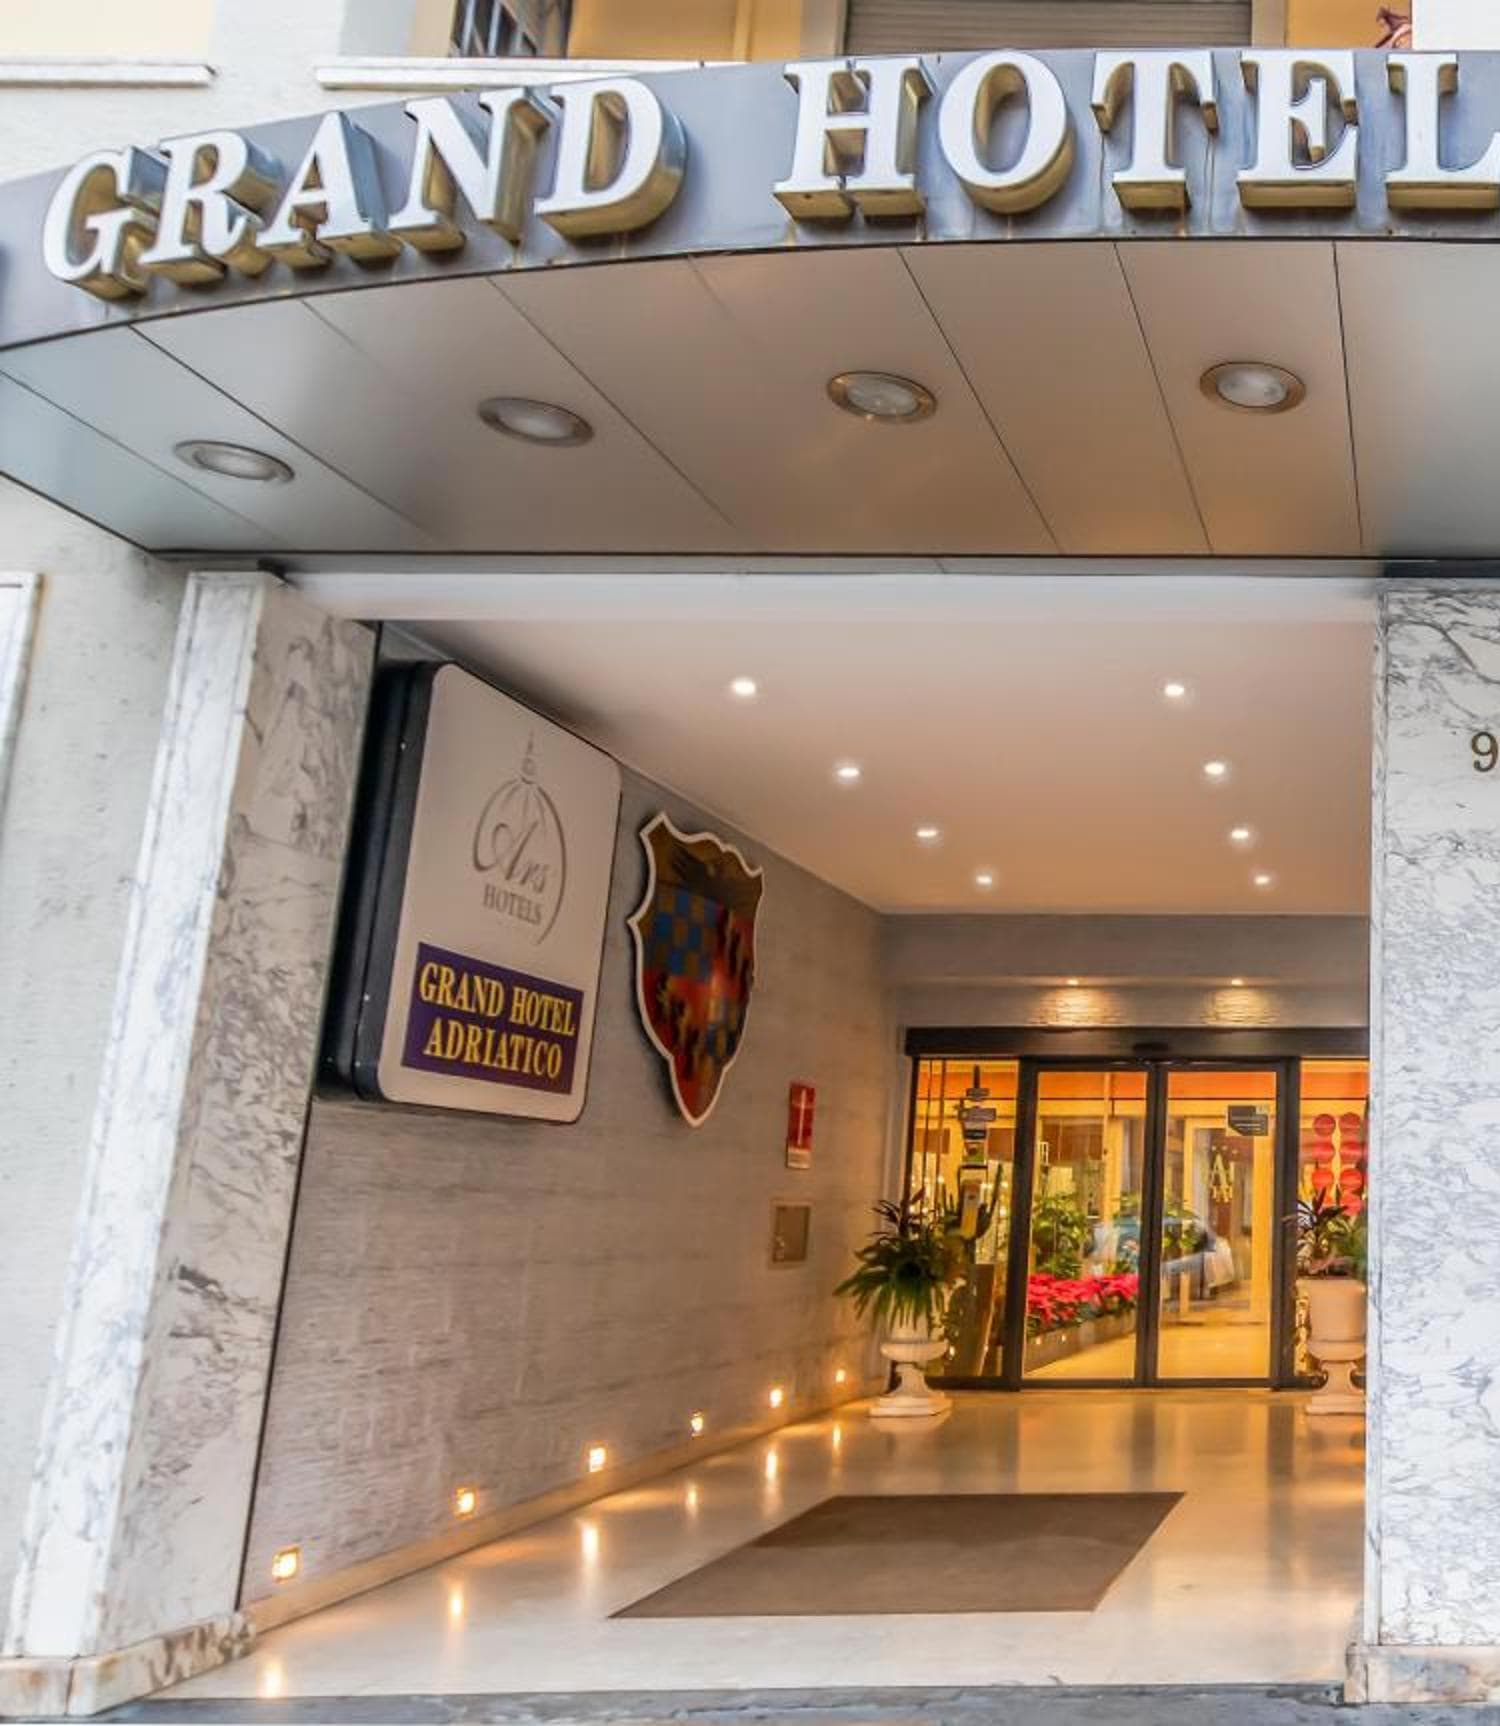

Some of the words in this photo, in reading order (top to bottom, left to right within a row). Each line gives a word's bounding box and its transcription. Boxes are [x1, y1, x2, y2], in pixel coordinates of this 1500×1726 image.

[42, 76, 672, 288] GRAND
[1471, 731, 1499, 772] 9
[483, 883, 543, 926] HOTELS
[419, 961, 505, 1018] GRAND
[510, 985, 575, 1037] HOTEL
[422, 1016, 563, 1080] ADRIATICO
